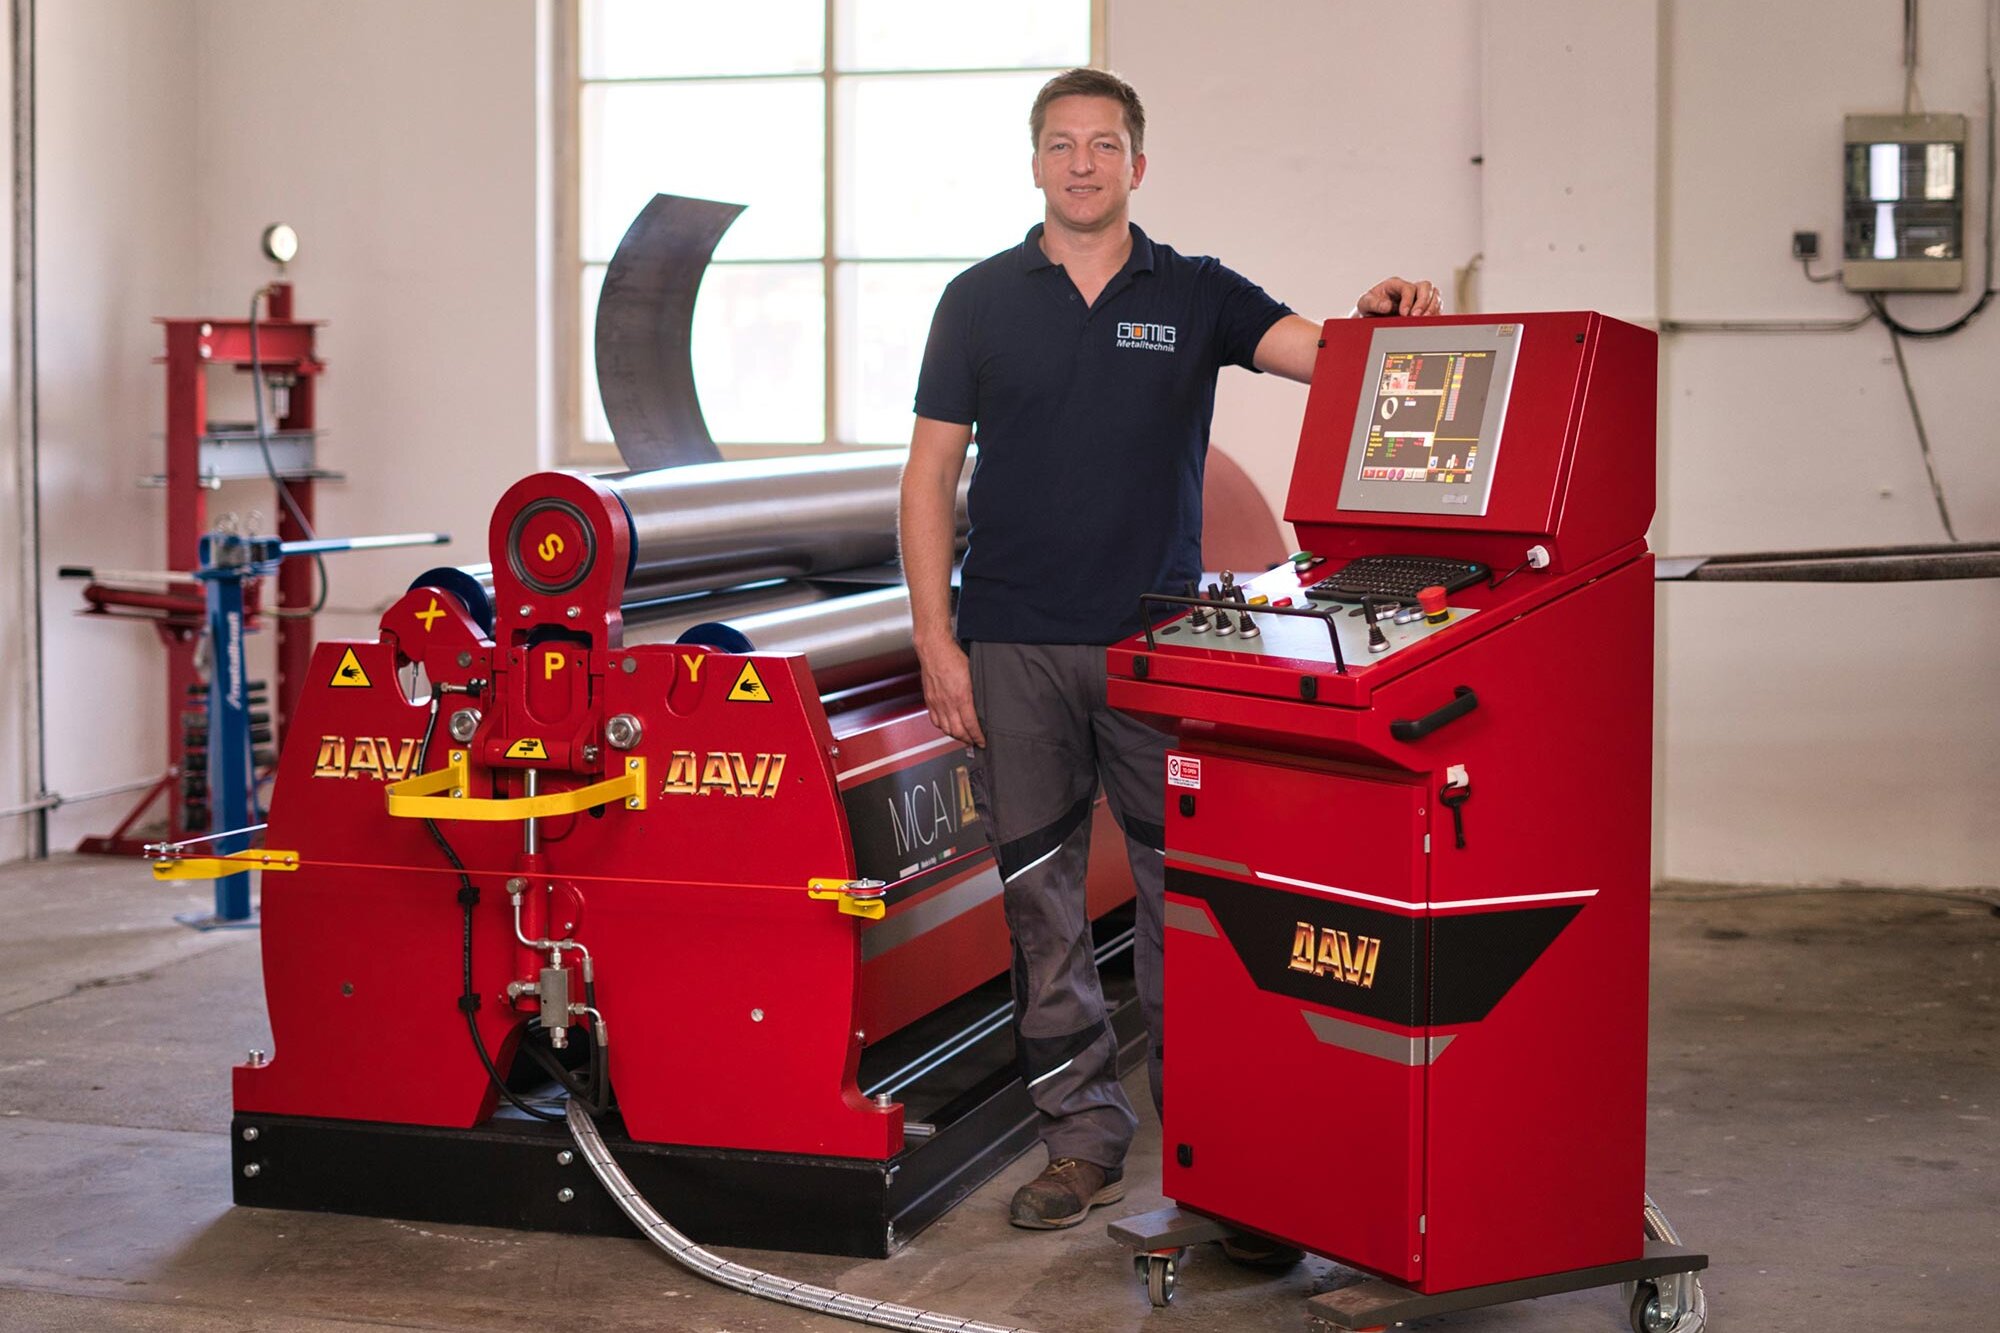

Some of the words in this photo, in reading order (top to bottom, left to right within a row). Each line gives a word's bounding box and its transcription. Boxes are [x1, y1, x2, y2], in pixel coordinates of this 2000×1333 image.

[1116, 339, 1175, 353] Metalltechnik
[1117, 322, 1176, 343] GOMIG
[538, 533, 564, 562] S
[415, 597, 447, 632] X
[545, 652, 565, 680] P
[682, 654, 705, 683] Y
[661, 751, 787, 798] DAVI
[888, 780, 952, 856] MCA
[1288, 921, 1381, 989] DAVI
